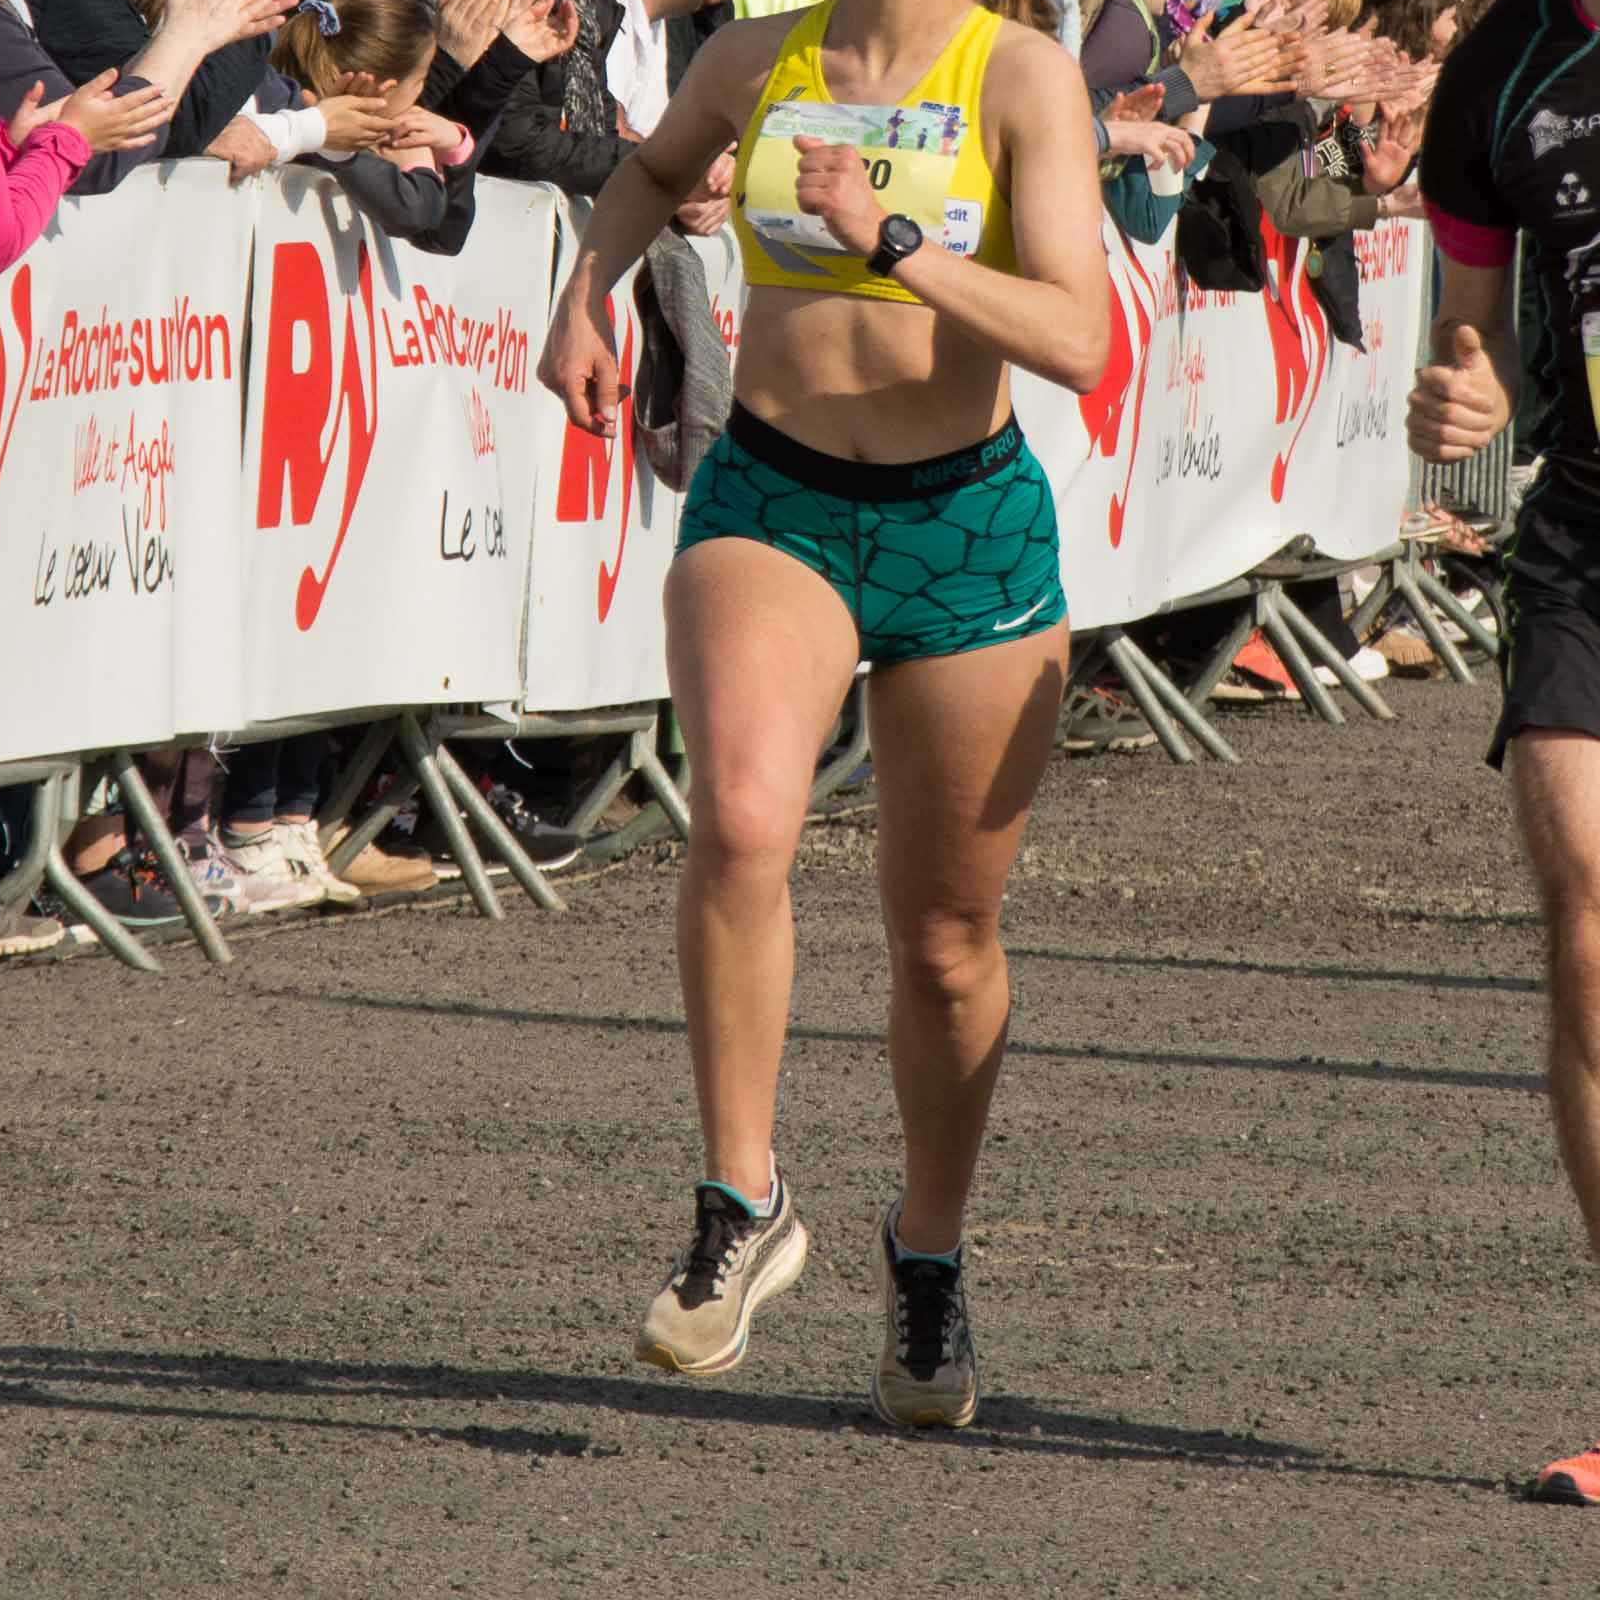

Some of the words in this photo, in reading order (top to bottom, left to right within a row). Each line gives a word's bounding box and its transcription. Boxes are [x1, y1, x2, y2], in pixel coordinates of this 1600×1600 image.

[55, 296, 232, 398] Roche-surYon
[911, 455, 979, 489] NIKE
[981, 425, 1016, 469] PRO
[122, 503, 175, 595] Ven
[441, 489, 476, 561] Le
